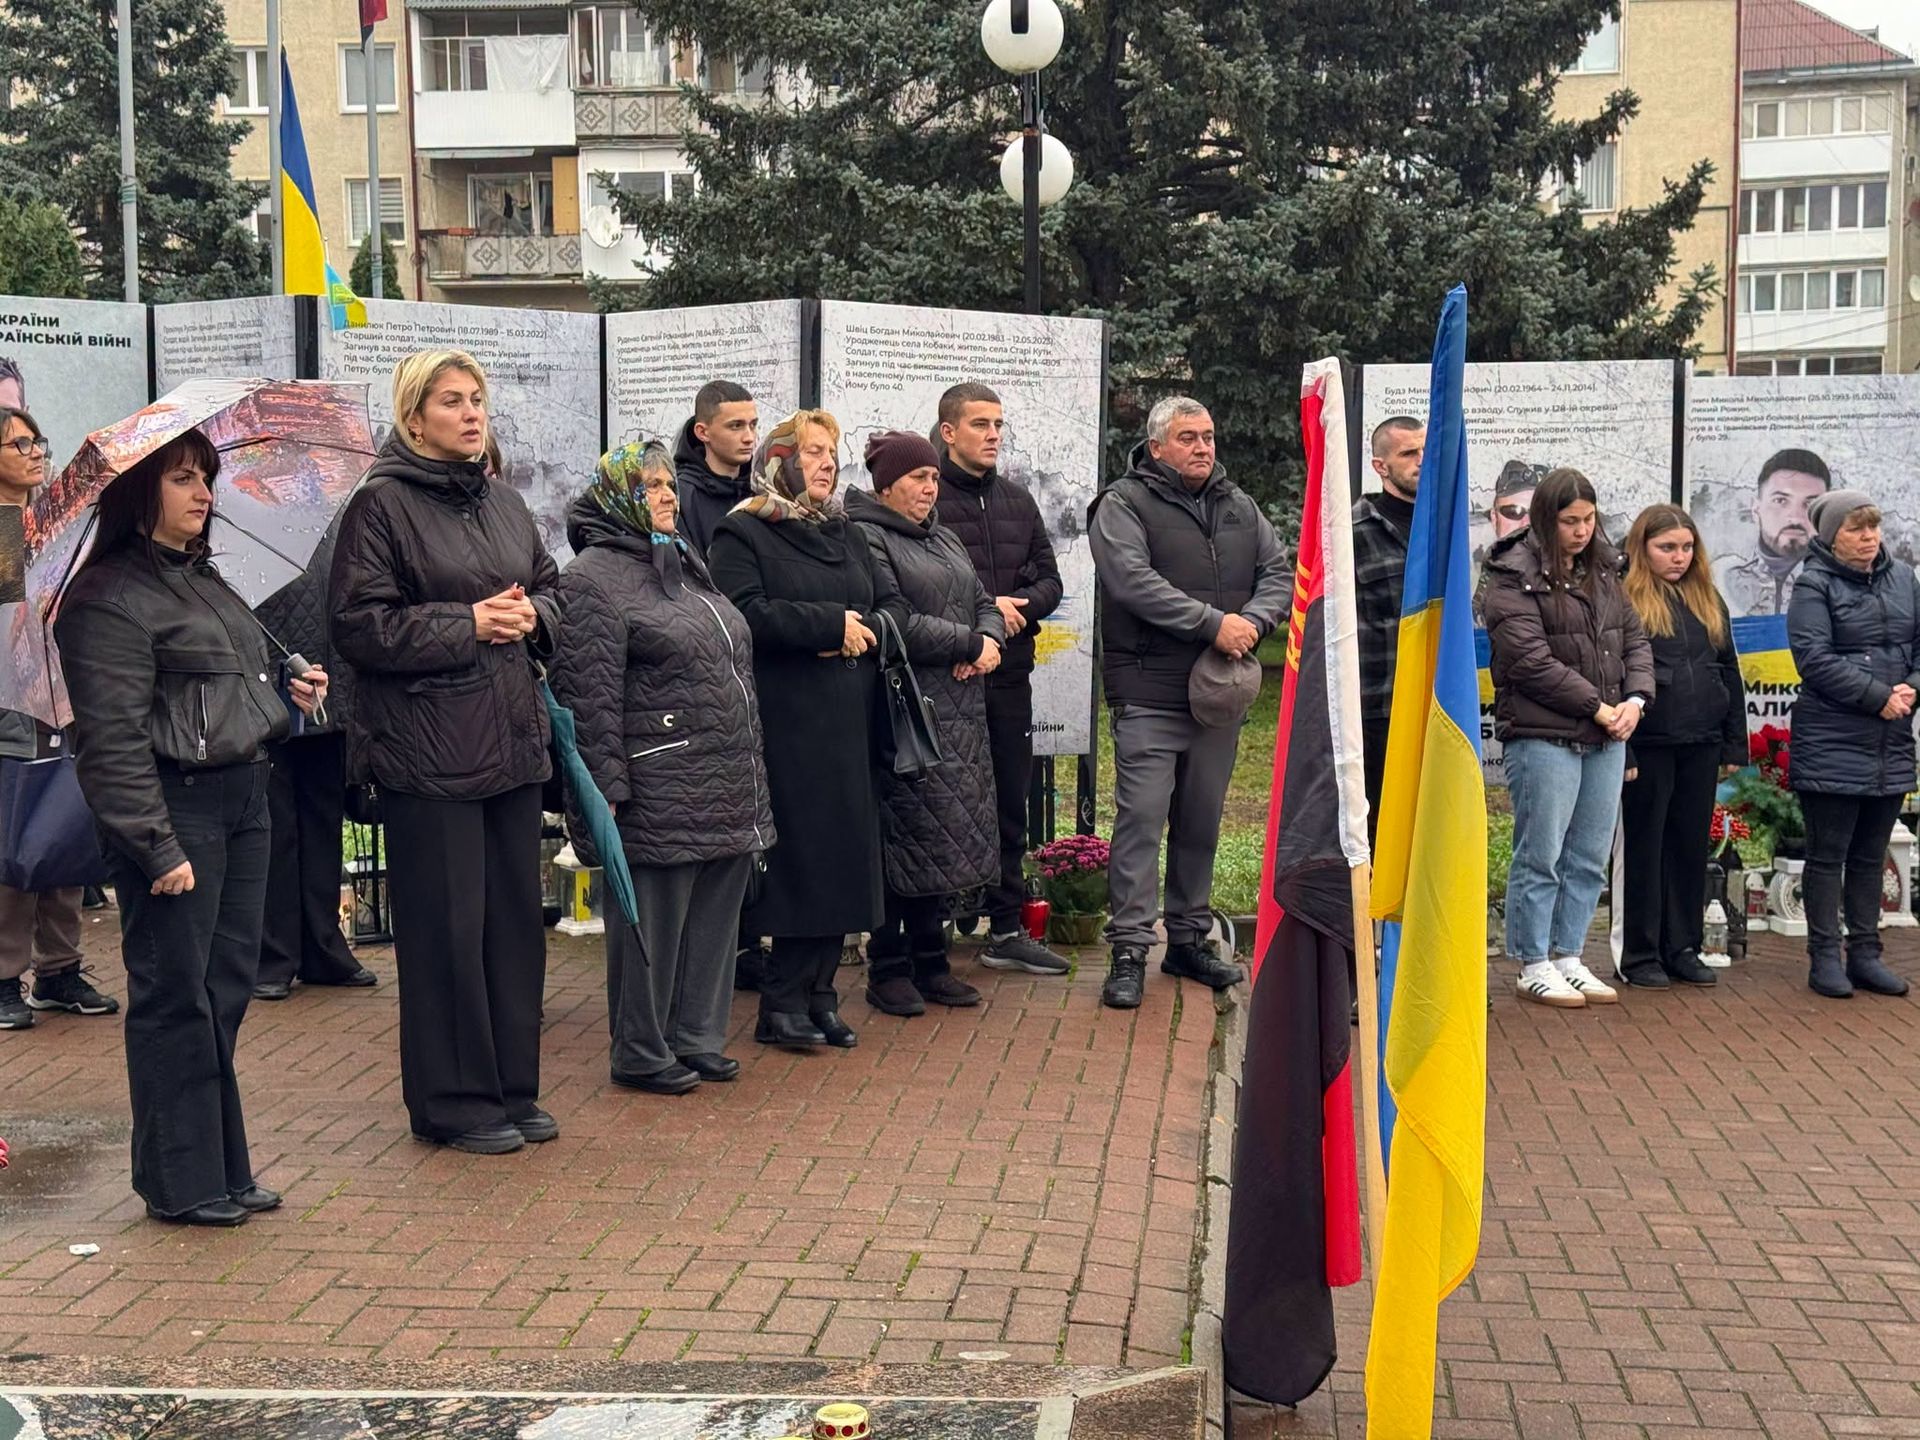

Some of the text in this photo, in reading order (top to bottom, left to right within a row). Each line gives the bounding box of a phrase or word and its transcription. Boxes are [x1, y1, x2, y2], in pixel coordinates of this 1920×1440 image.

[386, 322, 413, 331] Петро
[415, 323, 456, 334] Петрович
[846, 325, 868, 334] Швіц
[870, 326, 900, 336] Богдан
[903, 328, 960, 339] Миколайович
[88, 333, 131, 348] ВІЙНІ
[344, 331, 383, 341] Старший
[385, 335, 416, 344] солдат,
[344, 342, 379, 353] Загинув
[498, 350, 530, 359] України
[846, 335, 900, 347] Уродженець
[902, 340, 921, 348] села
[957, 344, 987, 353] житель
[989, 345, 1008, 353] села
[1010, 346, 1031, 356] Старі
[344, 353, 358, 363] під
[359, 355, 374, 363] час
[845, 347, 877, 358] Солдат,
[344, 364, 393, 375] Петру було
[846, 358, 880, 370] Загинув
[882, 360, 896, 369] під
[852, 370, 904, 382] населеному
[906, 373, 932, 383] пункті
[845, 380, 868, 391] Йому
[870, 381, 890, 392] було
[1385, 397, 1407, 405] Село
[1385, 406, 1421, 416] Капітан,
[1507, 405, 1542, 415] Служив
[1479, 438, 1511, 447] пункту
